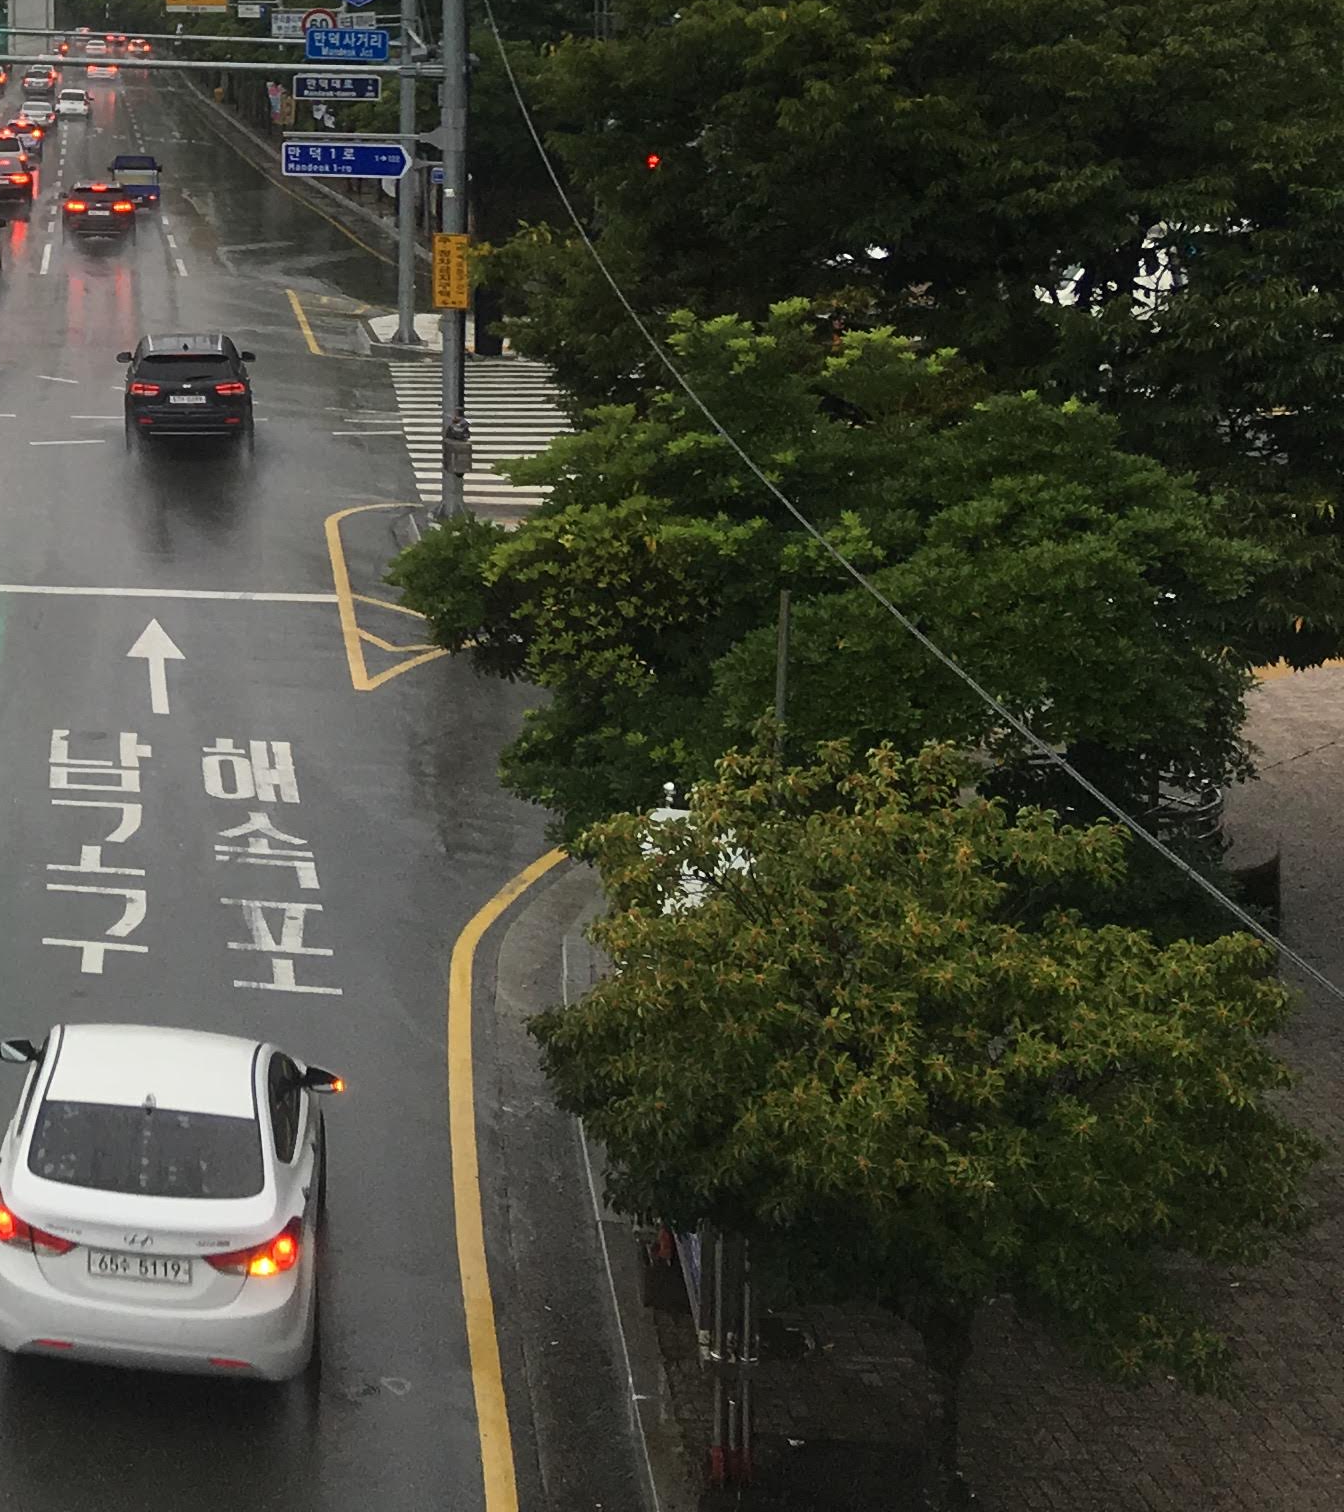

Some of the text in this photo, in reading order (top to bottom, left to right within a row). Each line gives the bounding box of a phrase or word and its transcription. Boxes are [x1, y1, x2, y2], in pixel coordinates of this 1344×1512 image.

[313, 31, 382, 48] 만덕사거리
[287, 146, 356, 162] 만덕1로
[139, 1258, 182, 1278] 5119
